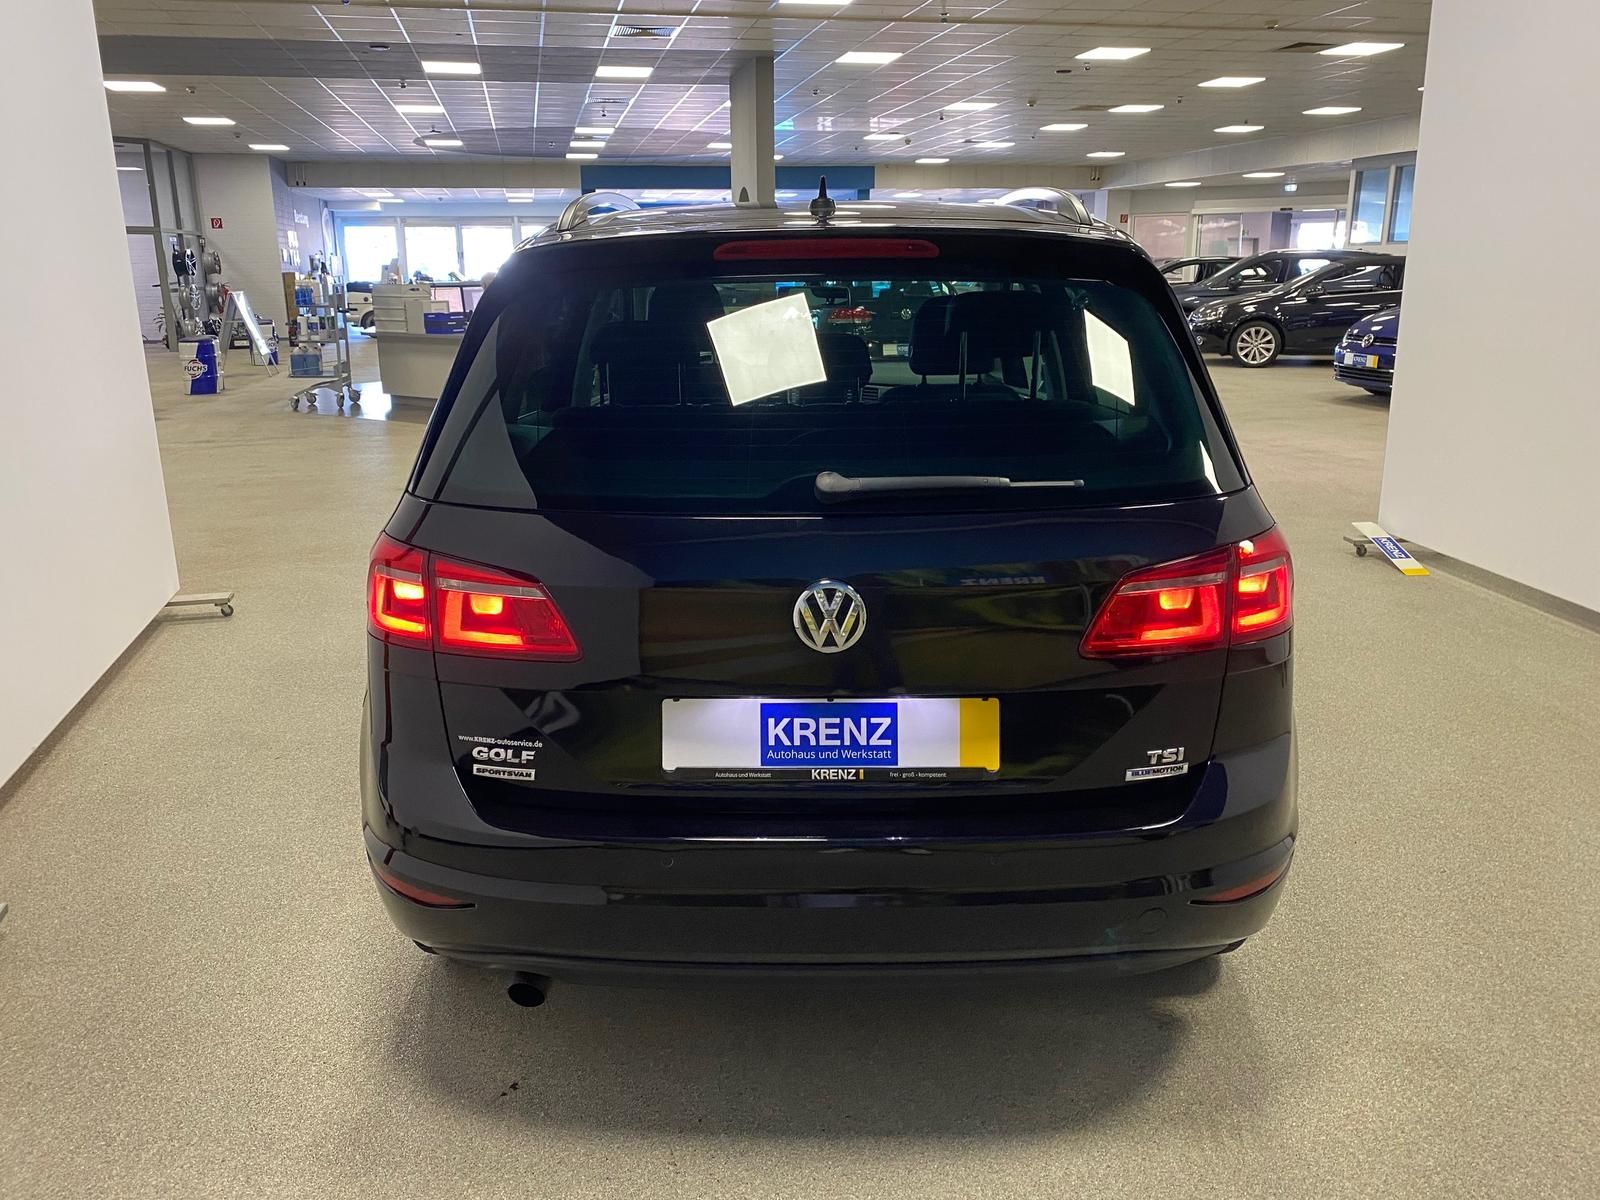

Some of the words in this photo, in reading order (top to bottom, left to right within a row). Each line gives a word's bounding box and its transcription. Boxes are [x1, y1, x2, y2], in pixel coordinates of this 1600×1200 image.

[184, 364, 208, 373] FUCHS
[767, 717, 892, 746] KRENZ
[458, 735, 543, 747] www.KRENZ-autoservice.de
[472, 746, 535, 763] GOLF
[767, 749, 816, 759] Autohaus
[819, 749, 838, 759] und
[841, 749, 892, 759] Werkstatt
[1146, 747, 1185, 765] TSI
[475, 767, 532, 778] SPORTSVAN
[811, 769, 856, 780] KRENZ
